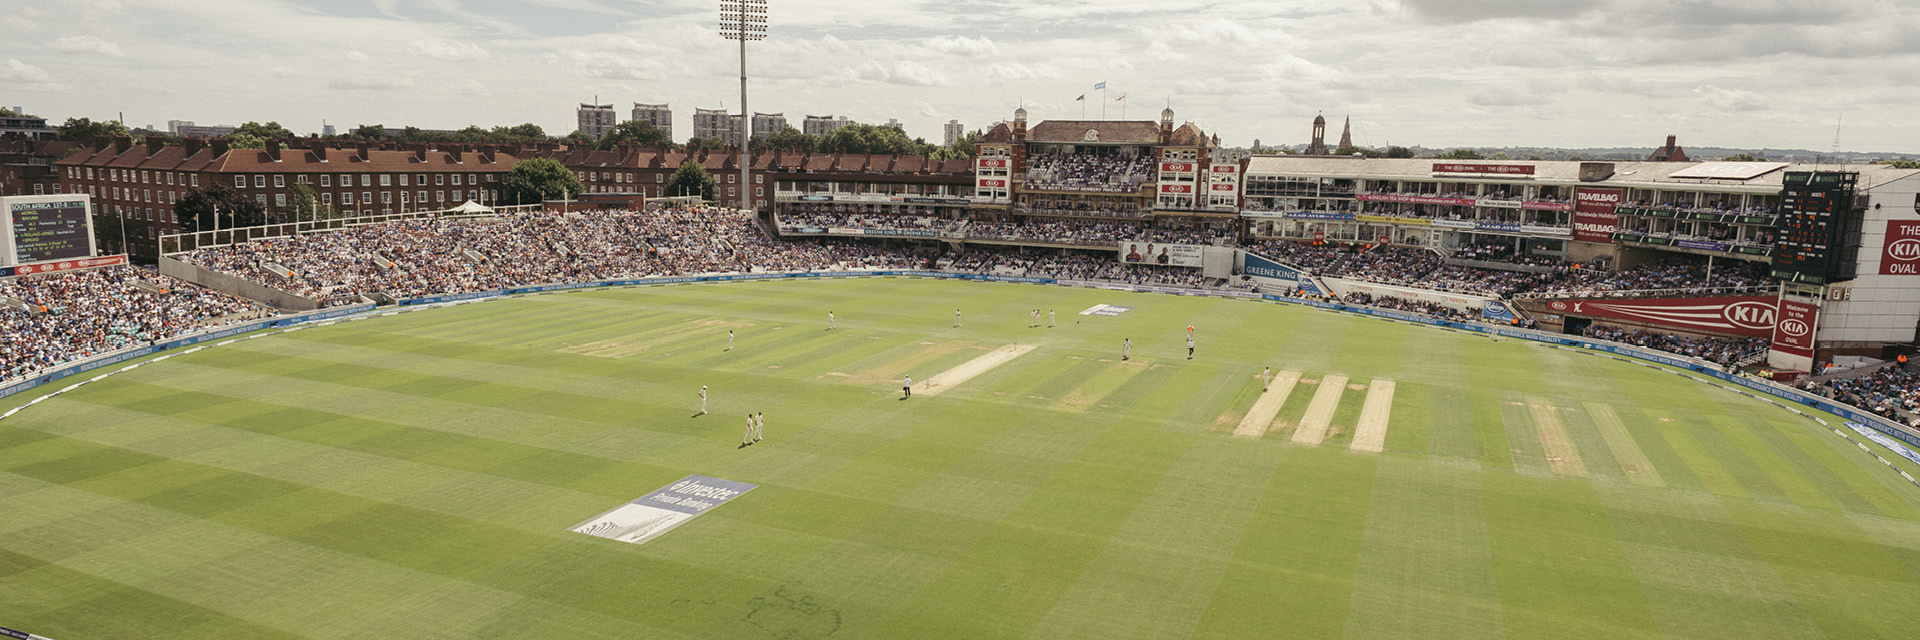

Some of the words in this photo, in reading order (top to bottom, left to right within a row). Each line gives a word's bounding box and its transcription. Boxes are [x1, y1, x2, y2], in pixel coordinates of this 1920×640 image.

[1578, 193, 1618, 201] TRAVELBAG
[1575, 223, 1615, 232] TRAVELBAG
[1900, 225, 1920, 235] THE
[1894, 244, 1920, 255] KIA
[1246, 266, 1274, 276] GREENE
[1277, 270, 1296, 279] KING
[1890, 264, 1917, 274] OVAL
[1786, 304, 1808, 313] Welcome
[1387, 312, 1408, 321] INSURANCE
[1734, 306, 1774, 325] KIA
[1784, 322, 1803, 333] KIA
[80, 362, 97, 372] HEALTH
[98, 356, 120, 367] INSURANCE
[121, 352, 133, 361] WITH
[134, 348, 152, 358] VITALITY
[1614, 348, 1632, 356] HEALTH
[1632, 352, 1658, 361] INSURANCE
[1672, 360, 1690, 368] VITALITY
[18, 382, 36, 392] VITALITY
[1732, 376, 1746, 385] HEALTH
[1747, 380, 1770, 393] INSURANCE
[1771, 387, 1783, 397] WITH
[1784, 391, 1803, 402] VITALITY
[1851, 414, 1867, 425] HEALTH
[1868, 419, 1893, 435] INSURANCE
[1894, 429, 1905, 439] WITH
[649, 492, 682, 504] Private
[676, 497, 713, 511] Banking
